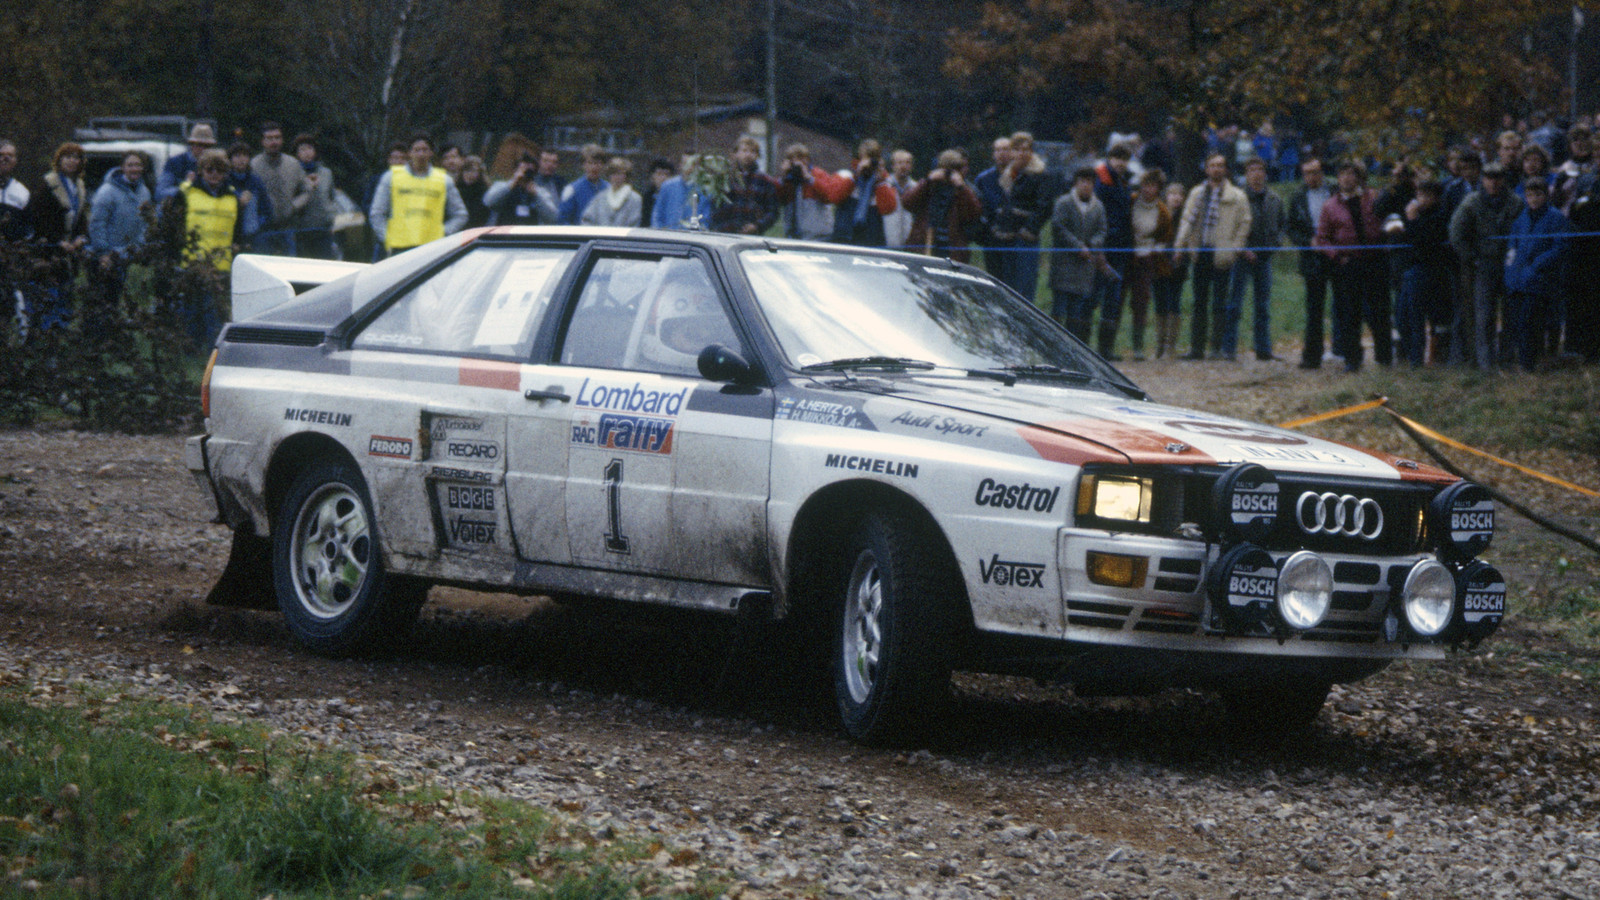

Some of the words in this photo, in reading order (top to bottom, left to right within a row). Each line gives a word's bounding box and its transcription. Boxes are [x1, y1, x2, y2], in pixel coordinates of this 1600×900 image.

[575, 377, 688, 416] Lombard
[285, 408, 352, 427] MICHELIN
[891, 410, 941, 429] Audi
[935, 417, 989, 437] Sport
[572, 426, 596, 444] RAC
[600, 418, 674, 452] rally
[371, 439, 411, 455] FERODO
[448, 443, 498, 459] RECARO
[825, 454, 919, 478] MICHELIN
[449, 488, 496, 509] BOGE
[975, 478, 1061, 513] Castrol
[1232, 493, 1278, 511] BOSCH
[604, 458, 631, 555] 1
[1451, 512, 1493, 530] BOSCH
[979, 554, 1046, 588] Votex
[1229, 576, 1275, 596] BOSCH
[1464, 594, 1504, 610] BOSCH
